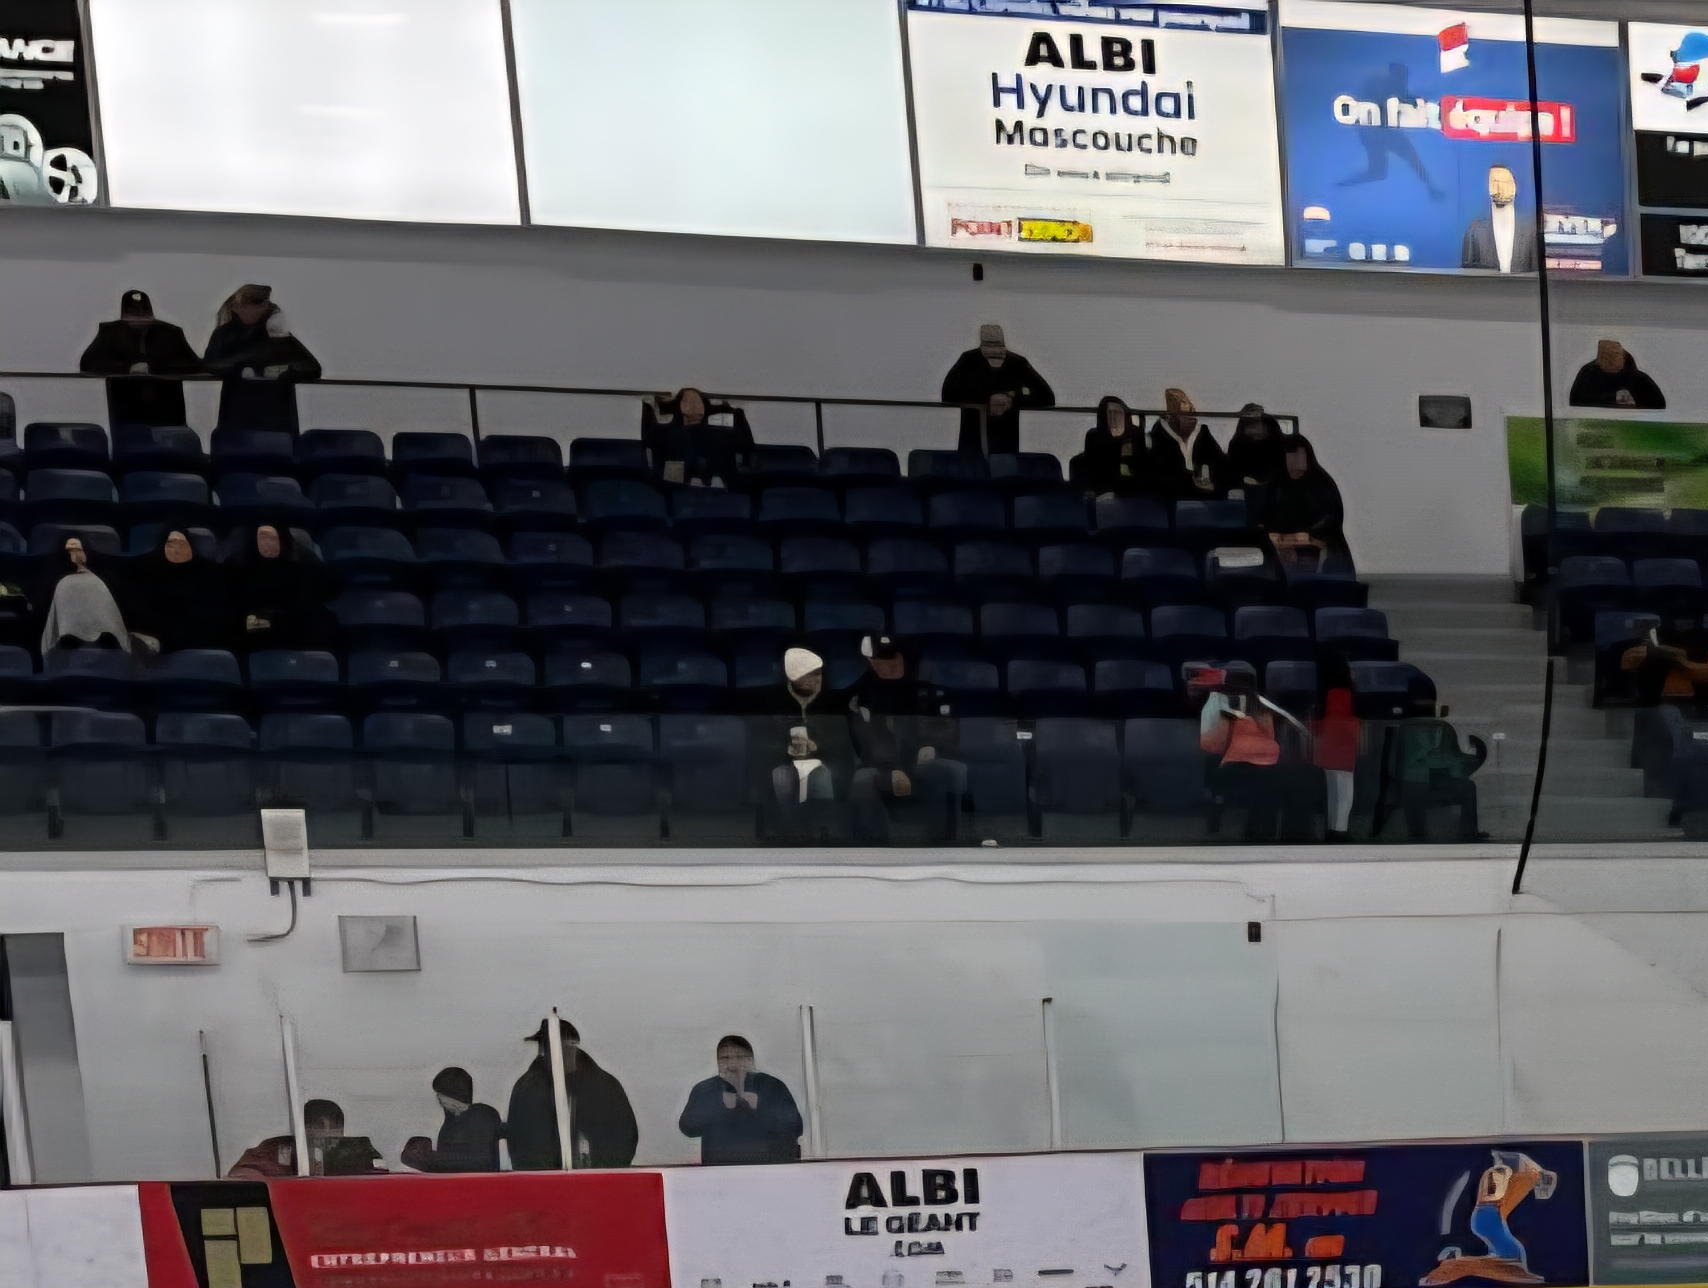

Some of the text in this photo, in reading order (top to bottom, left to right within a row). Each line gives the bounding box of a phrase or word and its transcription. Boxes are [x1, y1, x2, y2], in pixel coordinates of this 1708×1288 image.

[1024, 31, 1157, 75] ALBI
[991, 71, 1196, 120] Hyundai
[1333, 95, 1382, 127] On
[845, 1168, 980, 1210] ALBI
[844, 1216, 880, 1236] LE
